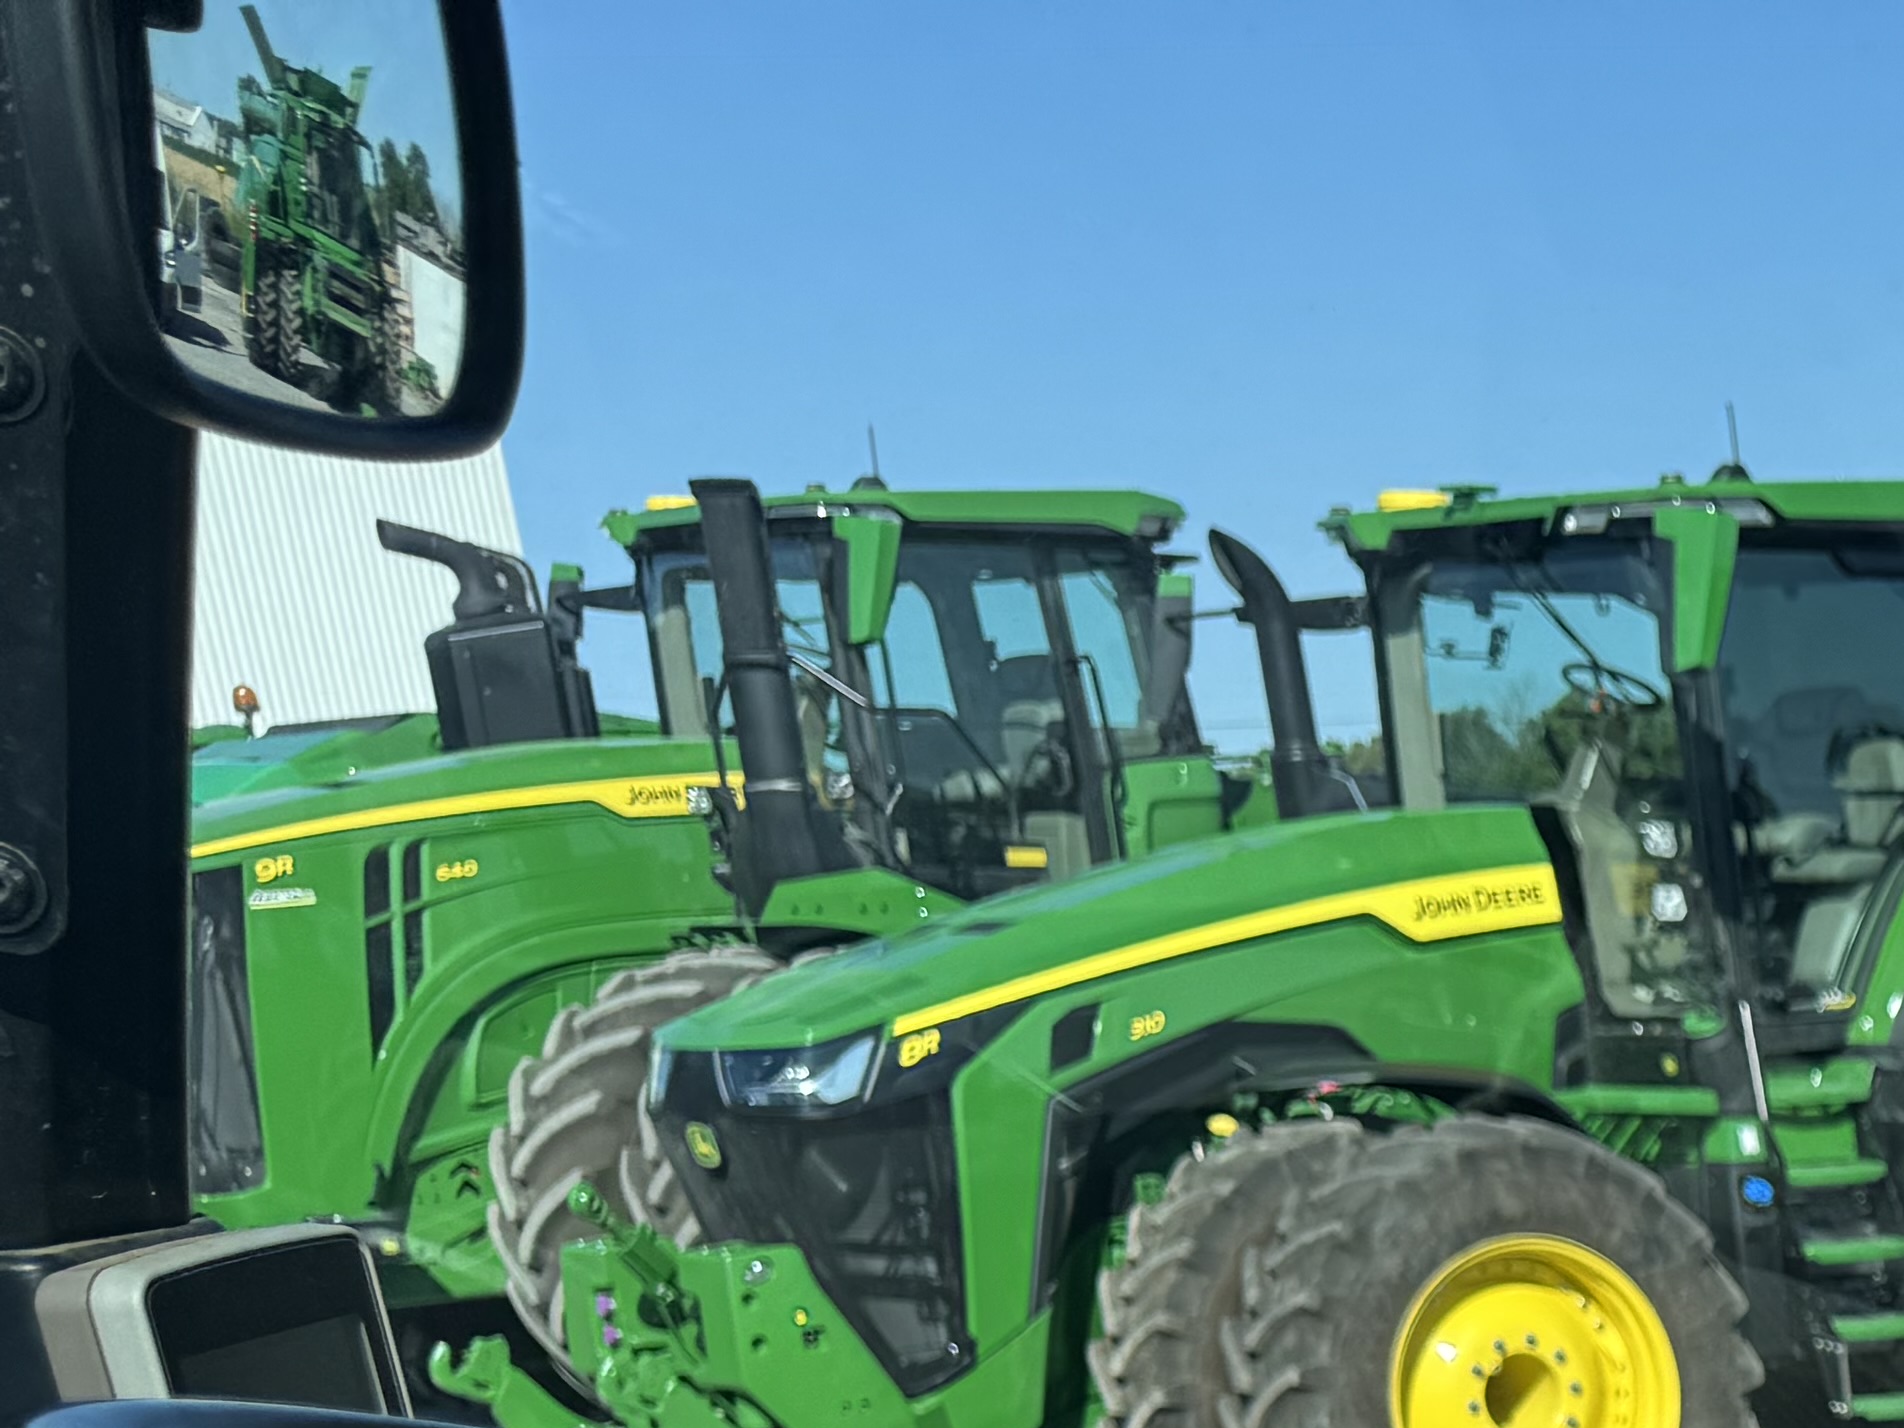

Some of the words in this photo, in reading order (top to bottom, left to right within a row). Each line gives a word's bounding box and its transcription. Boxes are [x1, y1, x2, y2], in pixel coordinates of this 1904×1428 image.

[254, 854, 294, 884] 9R
[1412, 892, 1471, 922] JOHN
[1471, 881, 1544, 914] DEERE
